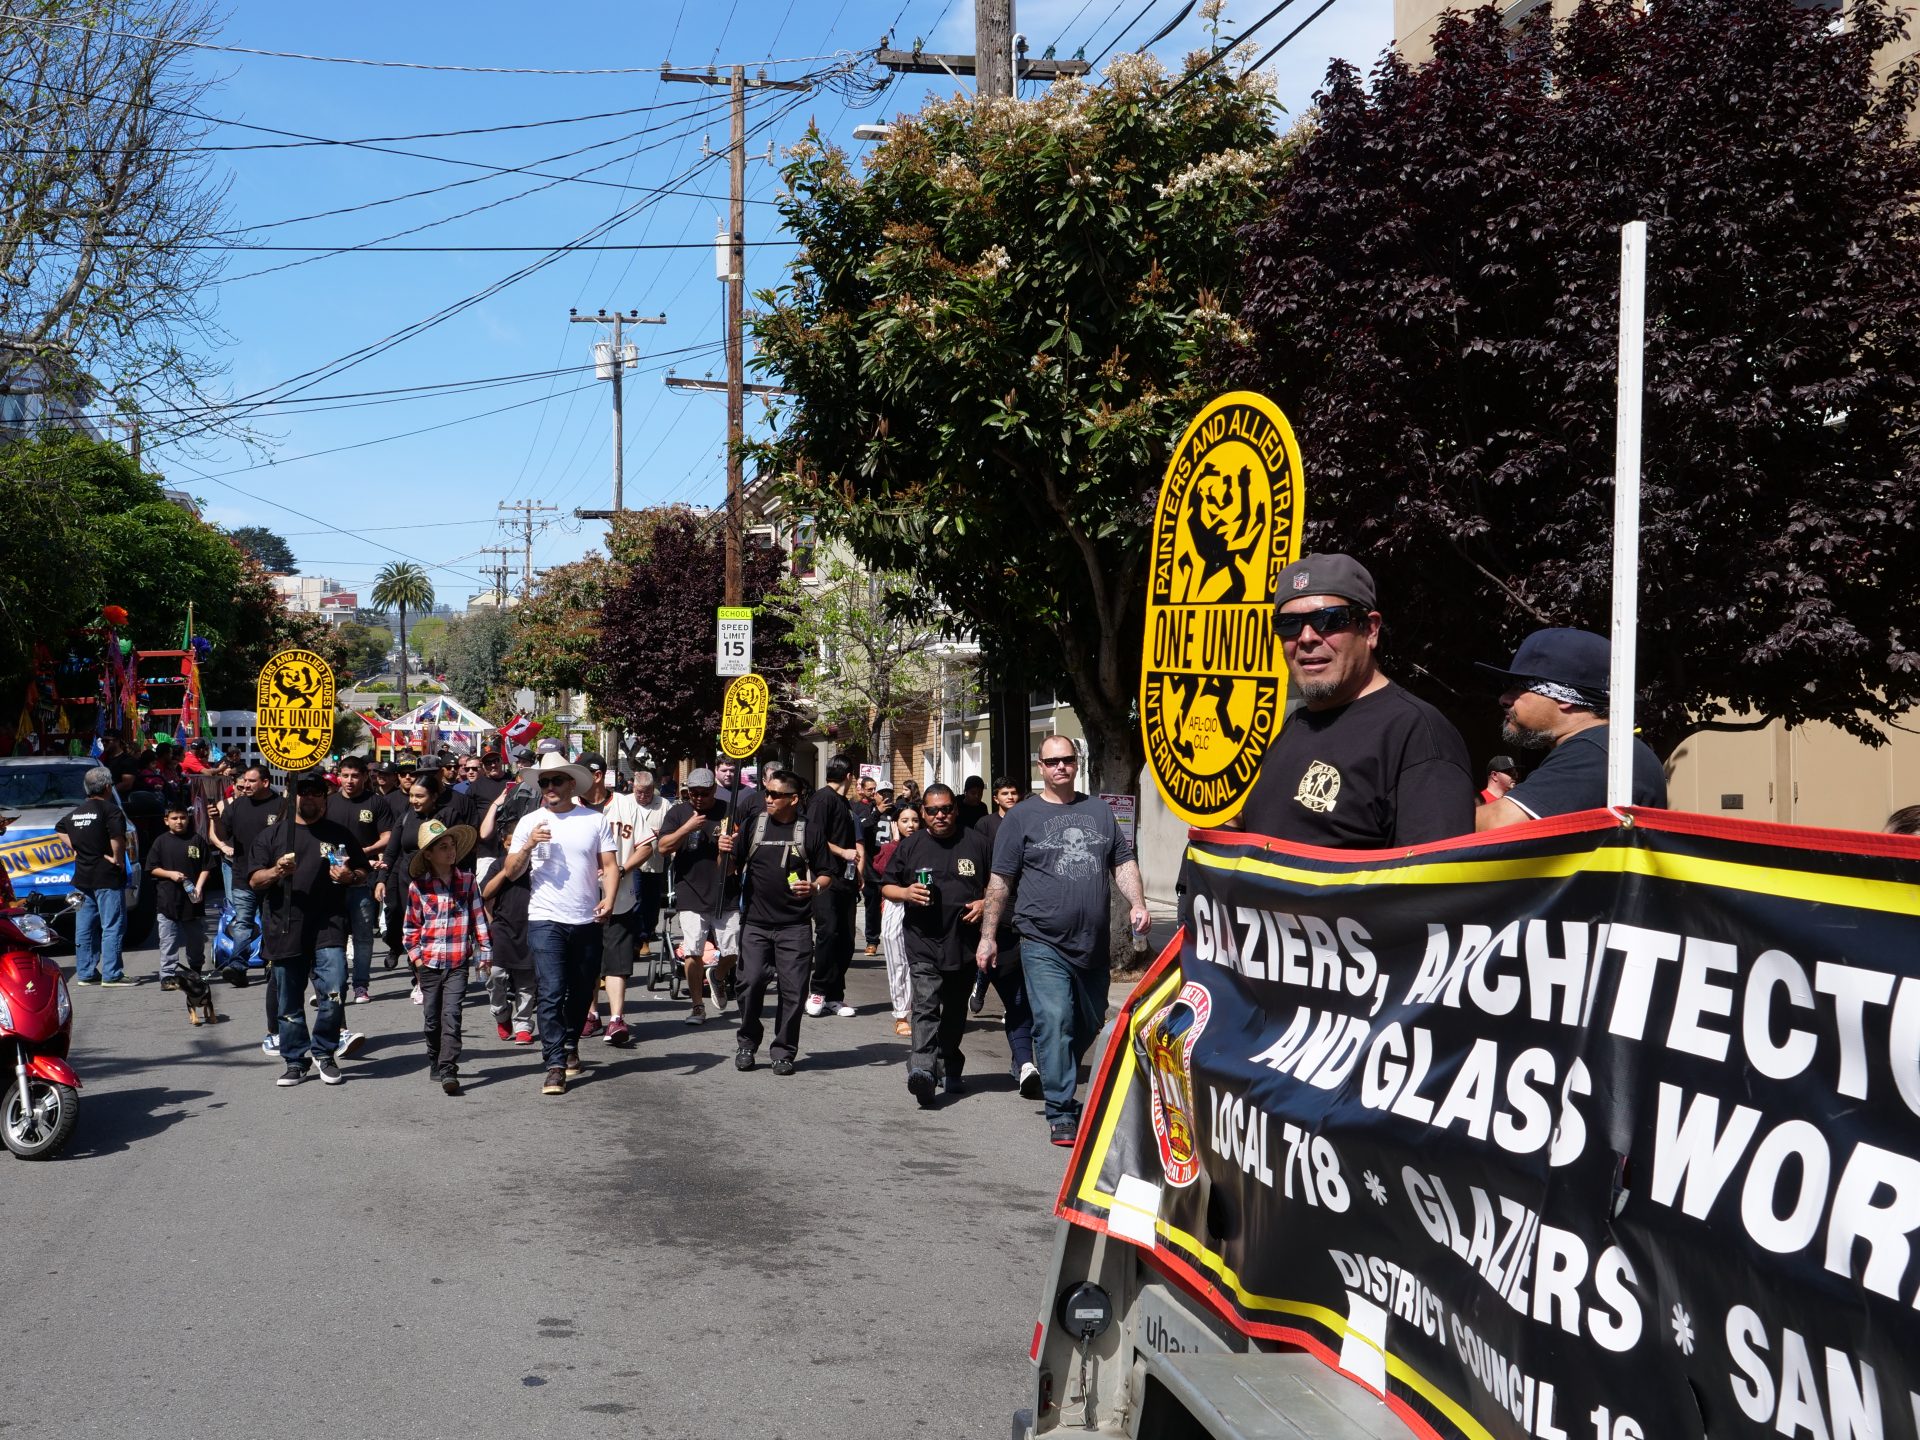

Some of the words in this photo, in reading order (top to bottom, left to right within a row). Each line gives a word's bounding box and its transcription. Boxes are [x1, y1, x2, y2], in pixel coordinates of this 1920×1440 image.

[1156, 456, 1191, 594] PAINTERS
[1193, 414, 1225, 463] AND
[1228, 409, 1285, 472] ALLIED
[1268, 471, 1292, 594] TRADES
[720, 610, 750, 618] SCHOOL
[721, 623, 749, 631] SPEED
[723, 632, 746, 640] LIMIT
[724, 641, 745, 657] 15
[1153, 609, 1196, 669] ONE
[1202, 608, 1275, 672] UNION
[260, 664, 277, 705] PAINTERS
[275, 653, 295, 667] AND
[296, 652, 326, 673] ALLIED
[321, 670, 332, 706] TRADES
[260, 708, 285, 727] ONE
[289, 709, 331, 728] UNION
[725, 716, 738, 729] ONE
[740, 715, 762, 728] UNION
[258, 730, 315, 768] INTERNATIONAL
[313, 732, 331, 758] UNION
[1147, 682, 1237, 807] INTERNATIONAL
[1235, 686, 1275, 783] UNION
[1194, 734, 1209, 750] CLC
[35, 873, 72, 884] LOCAL
[1193, 894, 1390, 1017] GLAZIERS,
[1249, 1006, 1370, 1090] AND
[1361, 1022, 1592, 1167] GLASS
[1651, 1081, 1920, 1309] WOR
[1210, 1085, 1273, 1188] LOCAL
[1283, 1122, 1350, 1213] 718
[1401, 1165, 1643, 1352] GLAZIERS
[1725, 1304, 1885, 1440] SAN
[1146, 1314, 1199, 1353] uha
[1328, 1249, 1446, 1346] DISTRICT
[1451, 1312, 1567, 1440] COUNCIL
